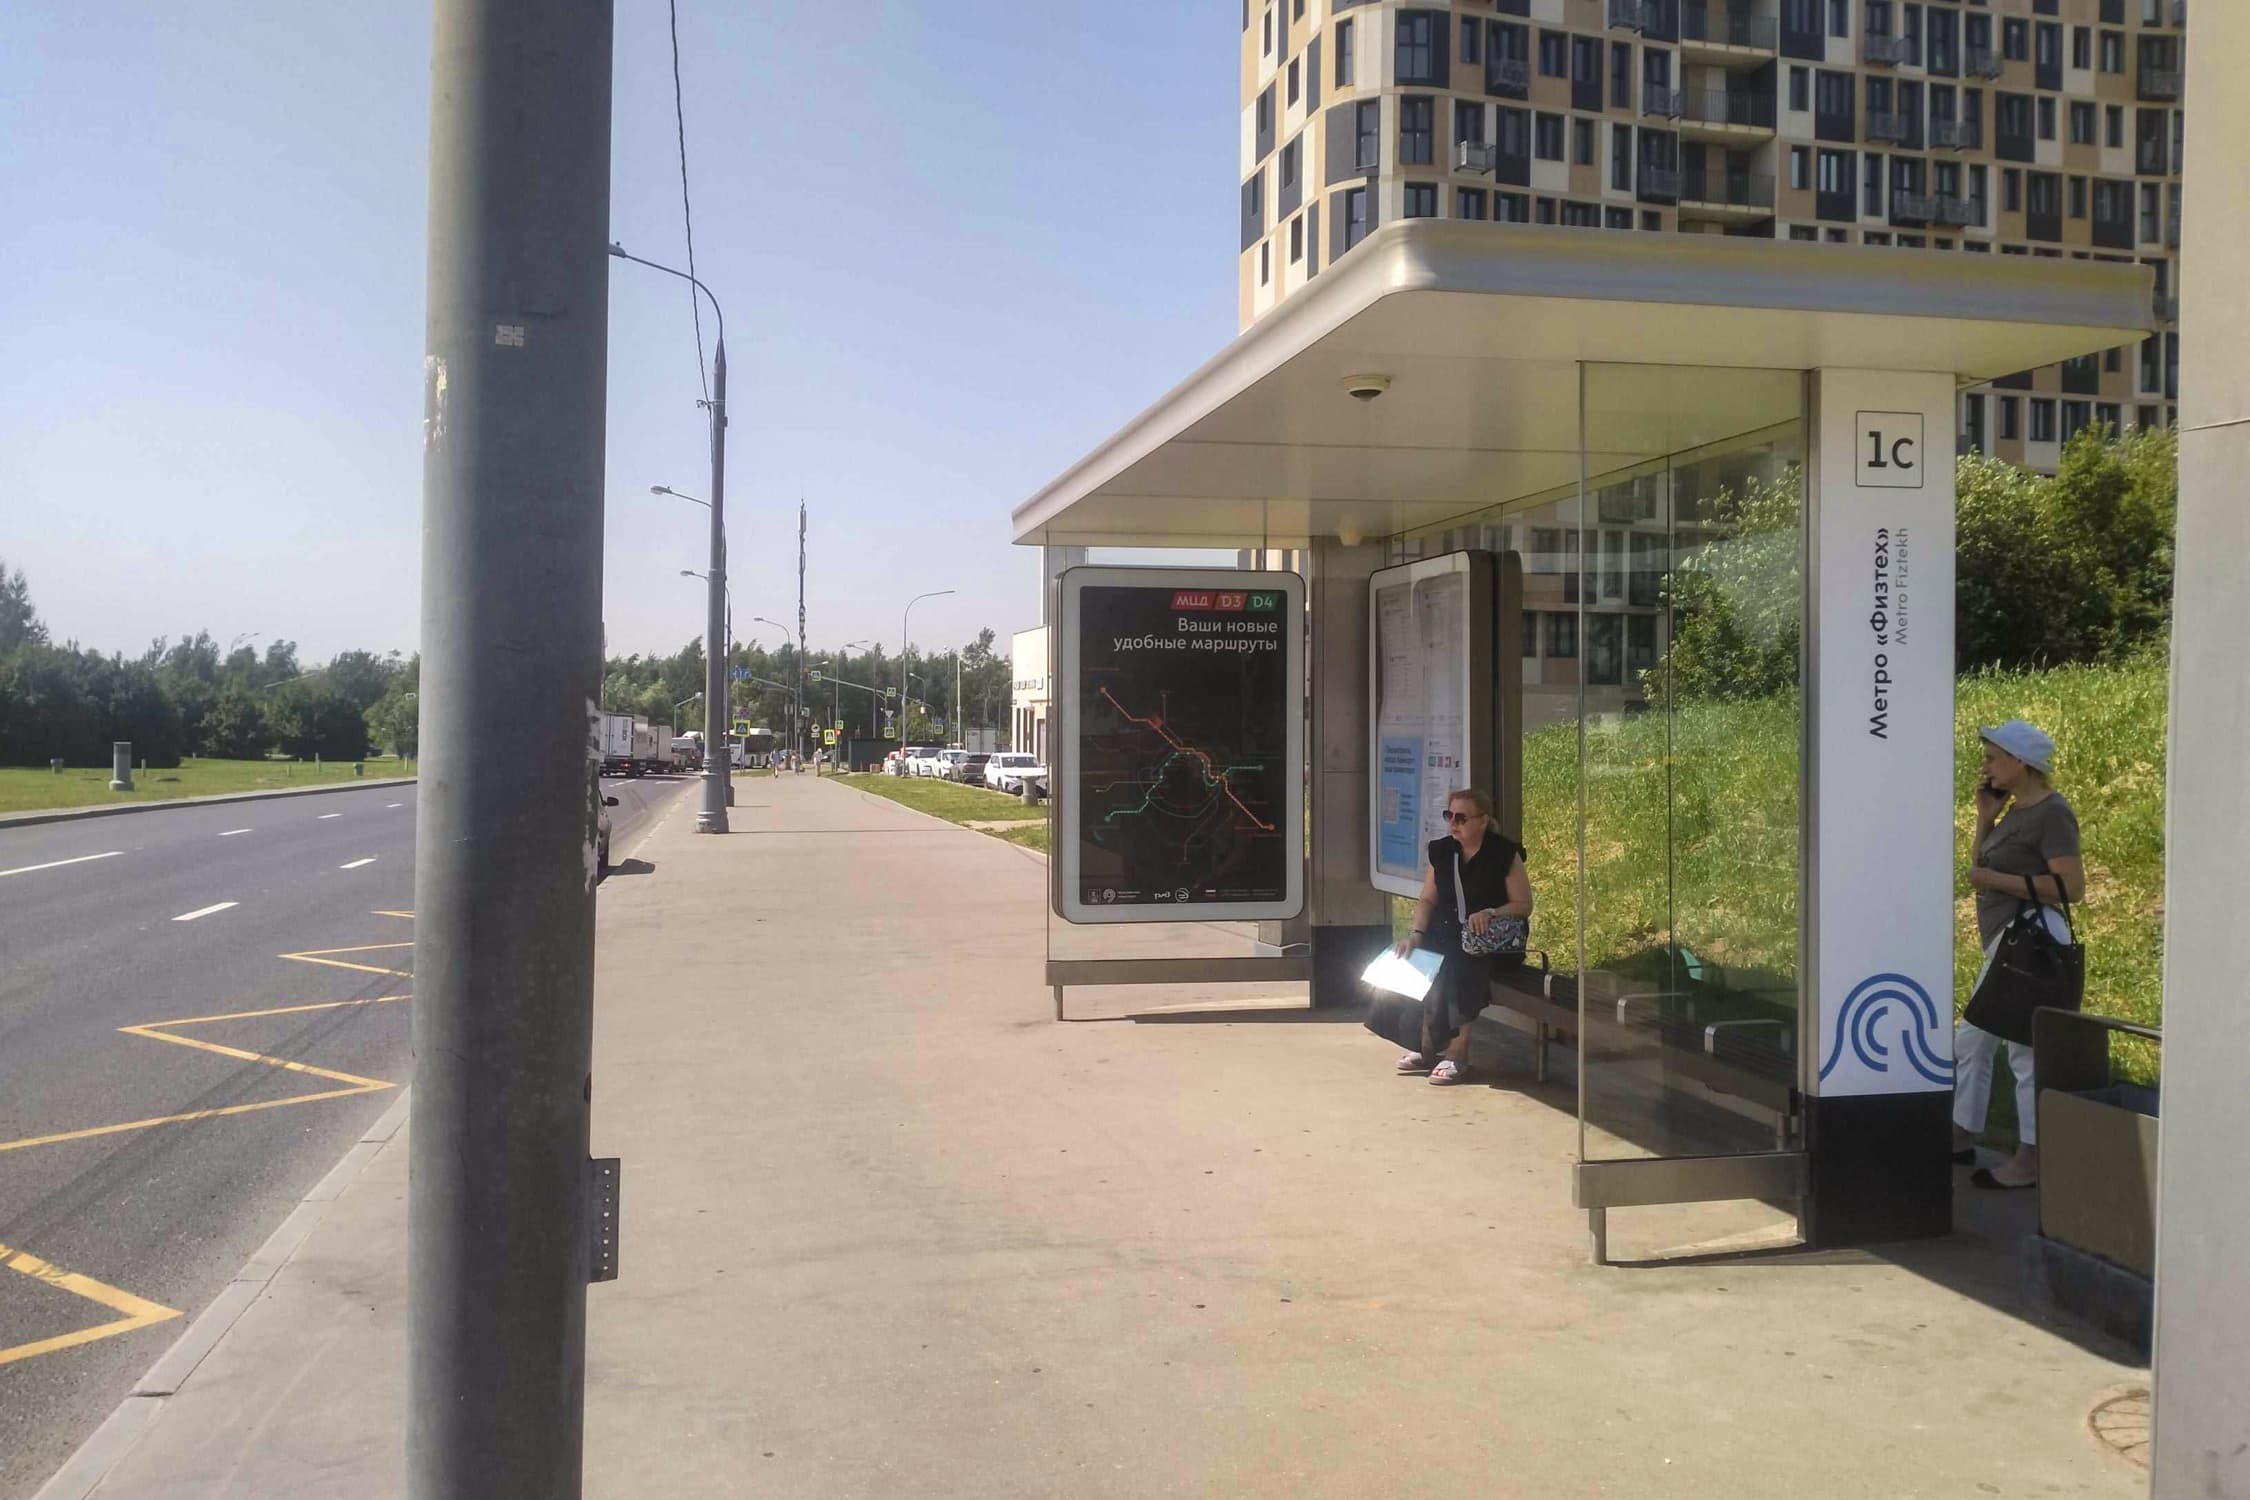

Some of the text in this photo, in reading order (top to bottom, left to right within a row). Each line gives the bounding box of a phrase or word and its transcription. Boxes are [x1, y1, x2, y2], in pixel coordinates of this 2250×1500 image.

[1895, 528, 1908, 645] Metro Fiztekh
[1176, 595, 1209, 607] МЦД
[1252, 596, 1273, 608] D4
[1178, 617, 1278, 633] Ваши новые
[1869, 527, 1892, 740] Метро «Физтех»
[1113, 634, 1277, 654] удобные маршруты
